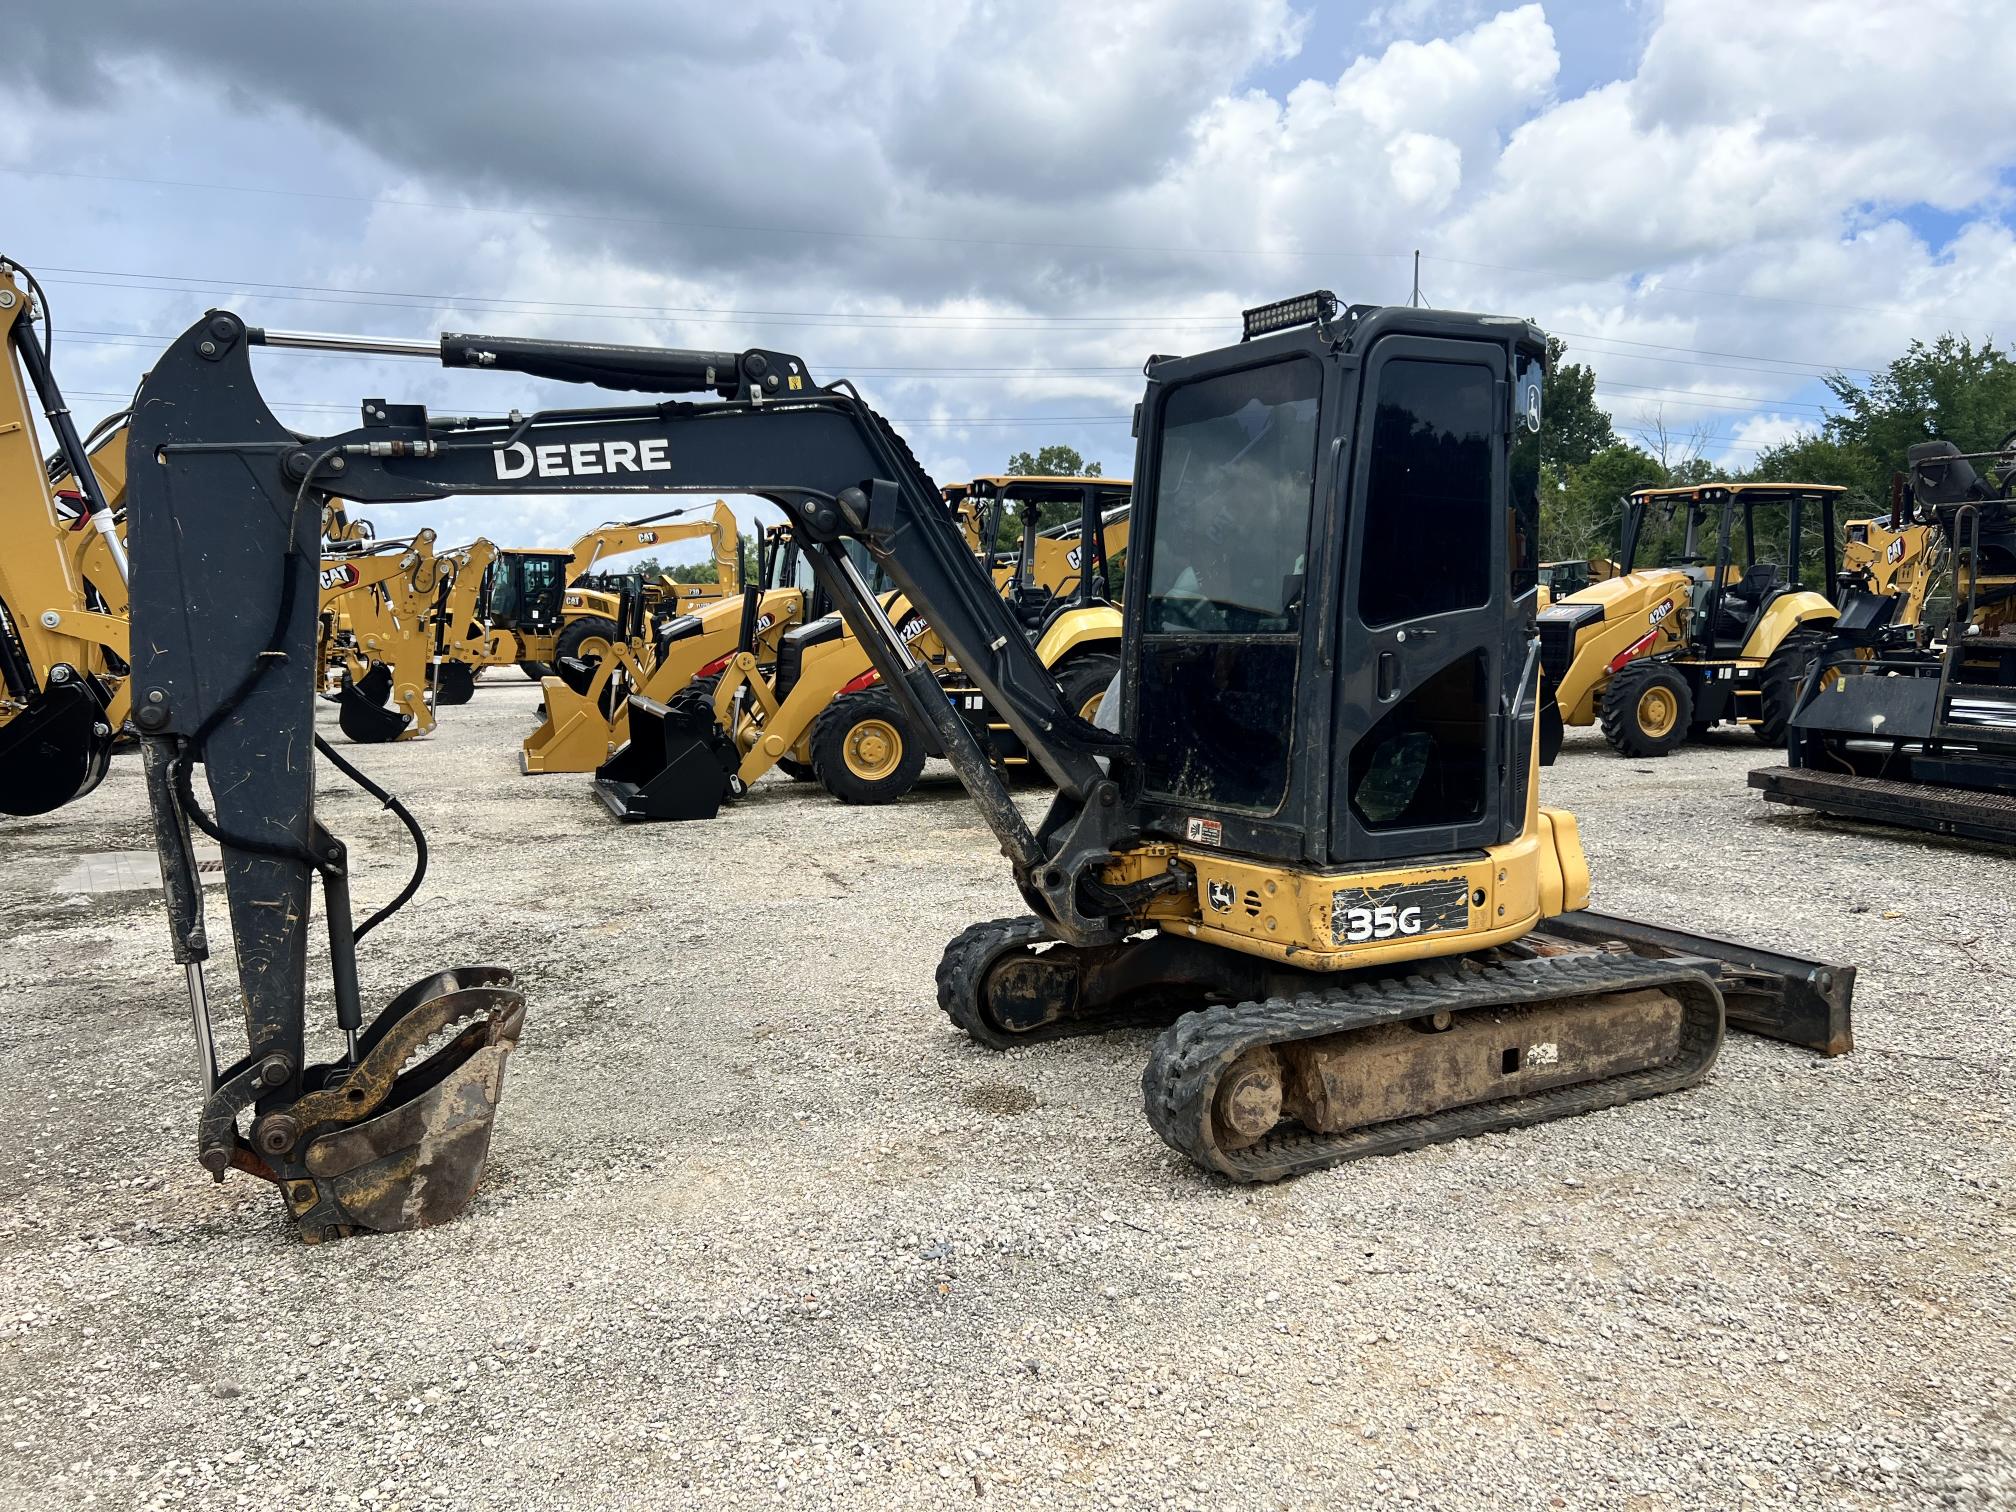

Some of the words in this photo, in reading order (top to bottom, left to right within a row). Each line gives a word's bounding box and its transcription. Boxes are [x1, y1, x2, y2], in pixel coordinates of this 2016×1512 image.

[492, 438, 672, 480] DEERE
[638, 532, 654, 544] CAT
[1887, 537, 1902, 564] CAT
[320, 564, 350, 590] CAT
[566, 597, 580, 605] CAT
[1649, 601, 1672, 625] 420XE
[756, 615, 771, 632] 20
[1347, 905, 1421, 940] 35G
